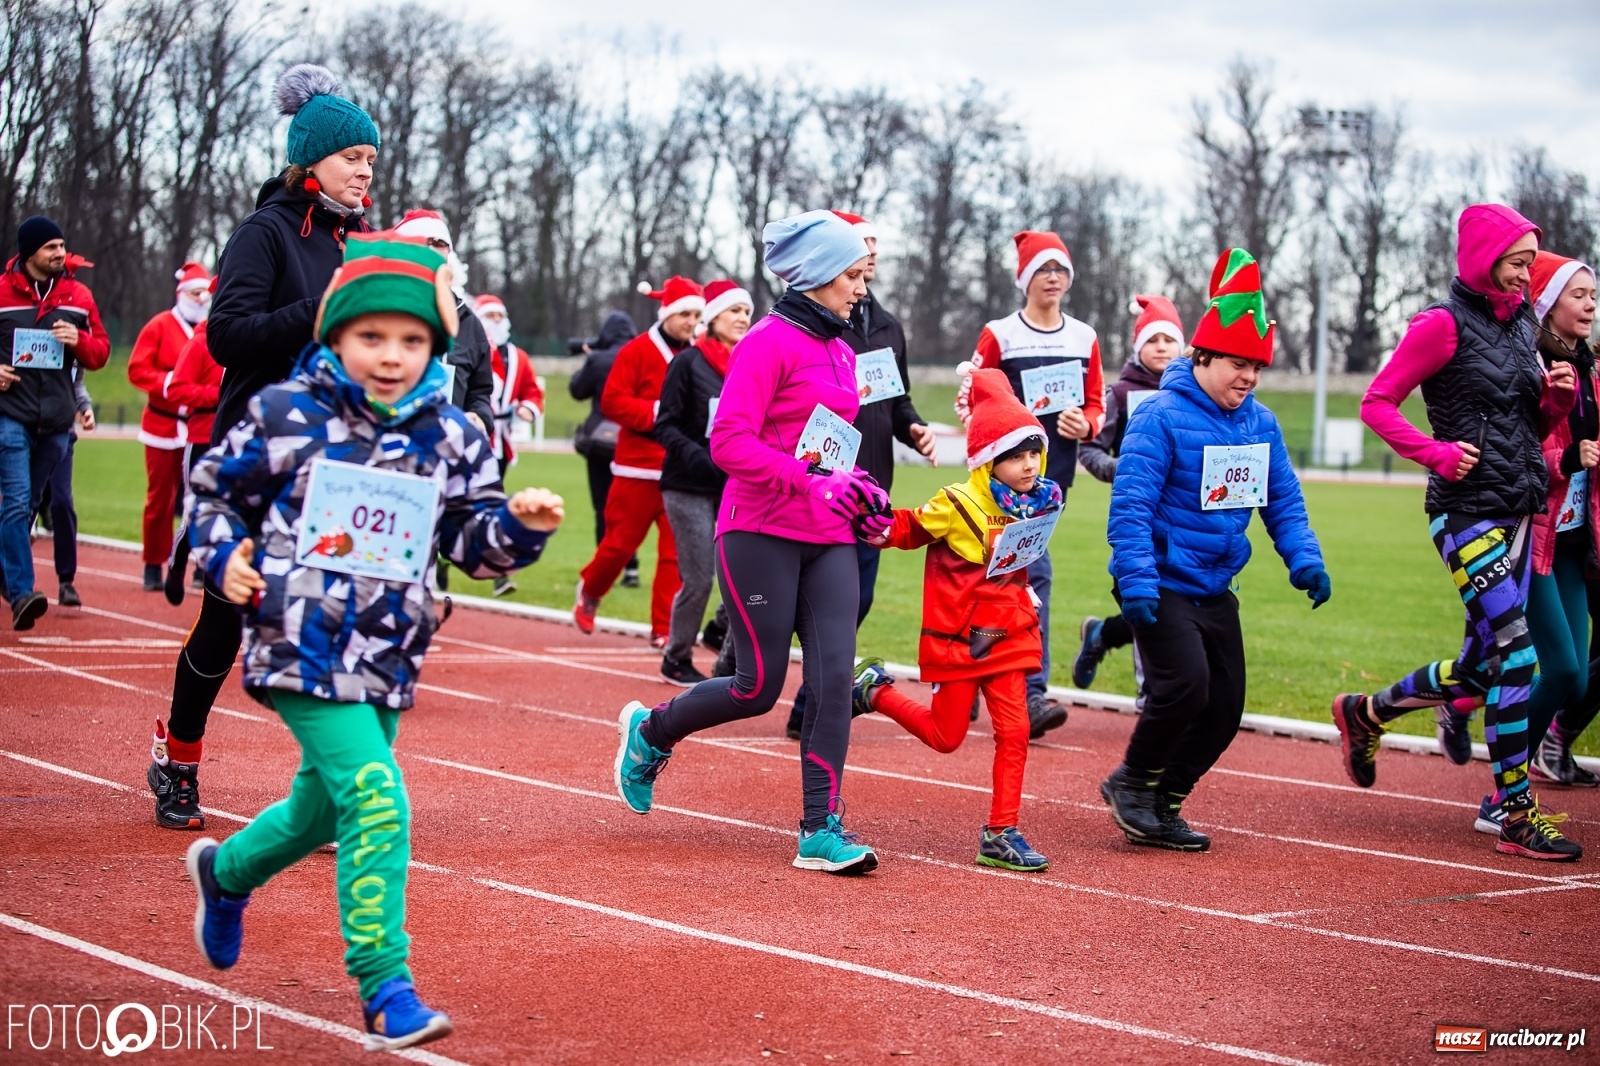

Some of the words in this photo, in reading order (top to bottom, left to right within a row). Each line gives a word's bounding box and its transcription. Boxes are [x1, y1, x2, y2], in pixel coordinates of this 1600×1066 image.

[31, 343, 48, 352] 019
[865, 368, 883, 382] 013
[1044, 381, 1065, 394] 027
[823, 437, 841, 460] 071
[1225, 467, 1249, 483] 083
[352, 505, 397, 536] 021
[1017, 531, 1042, 550] 067
[355, 761, 401, 867] CHILL
[347, 875, 387, 951] OUT
